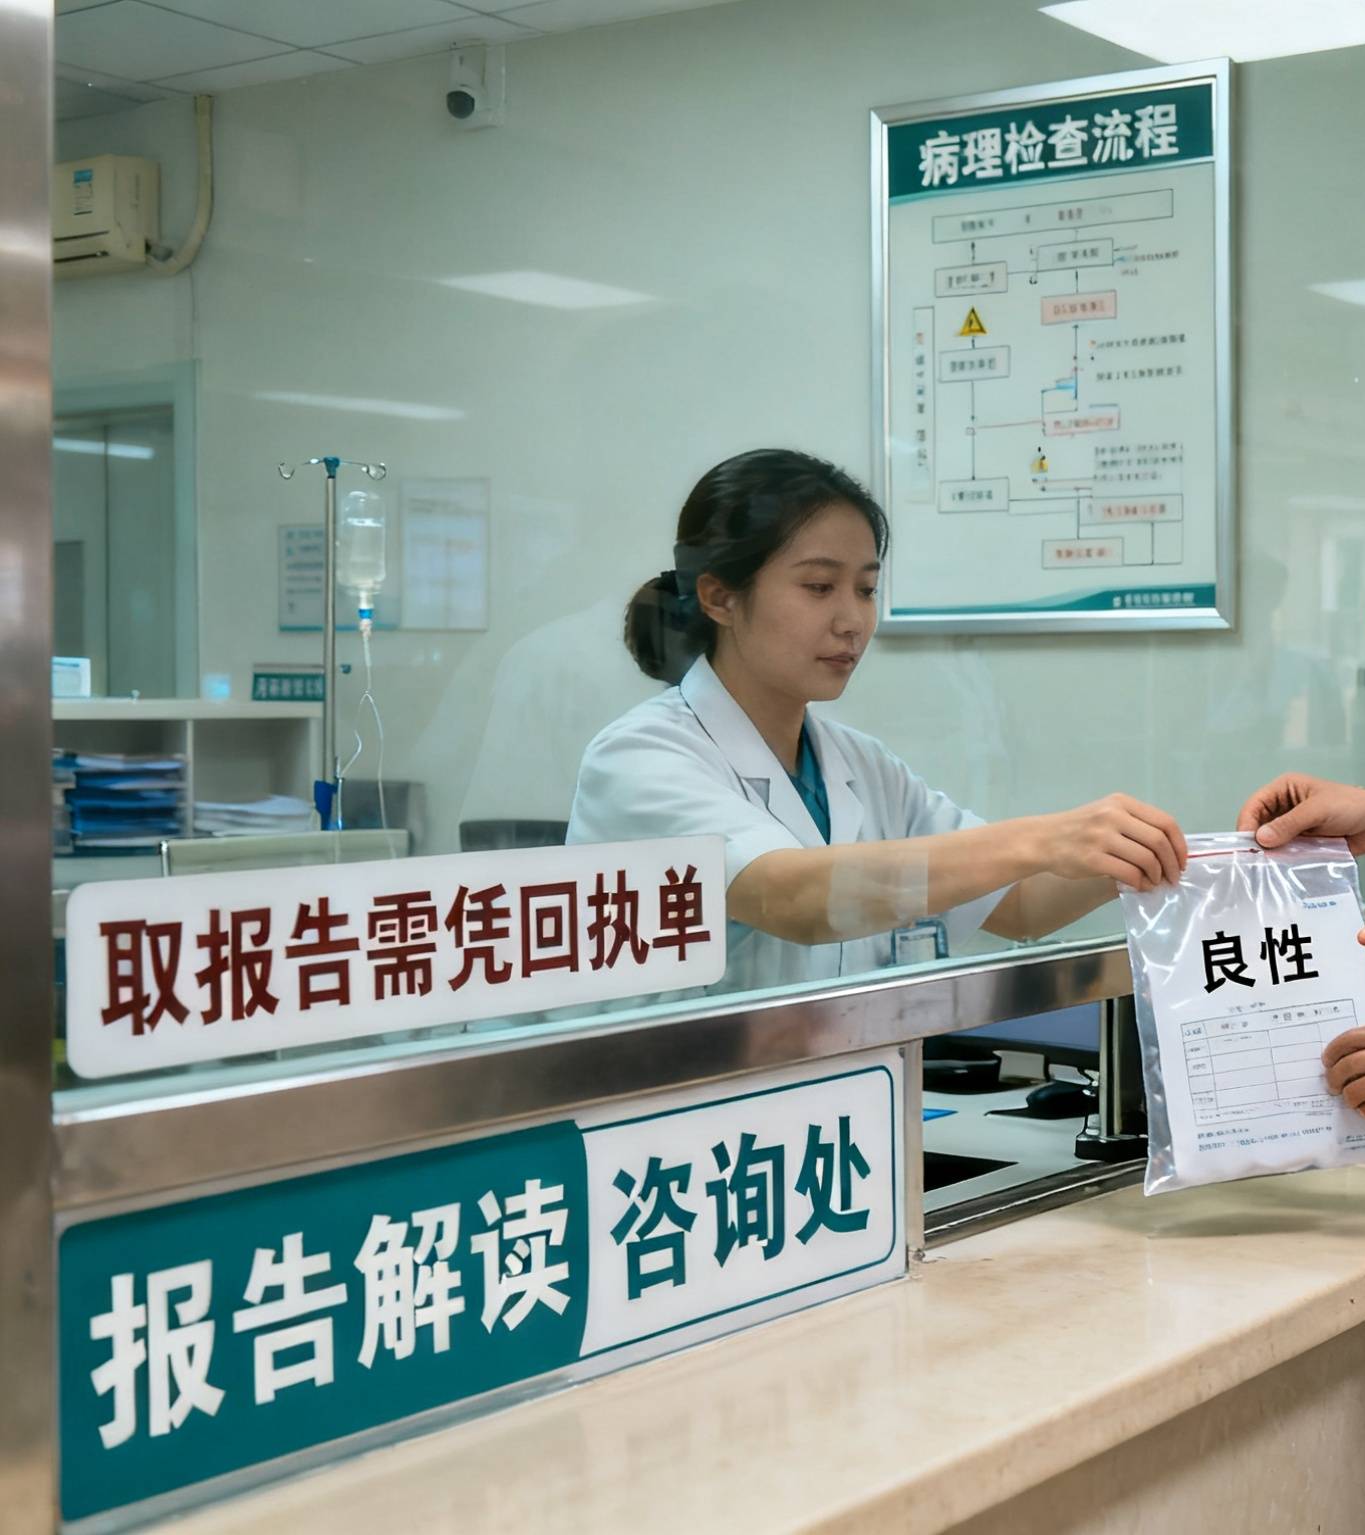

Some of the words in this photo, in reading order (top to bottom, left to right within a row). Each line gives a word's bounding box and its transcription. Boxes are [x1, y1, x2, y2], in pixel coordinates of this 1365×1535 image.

[919, 104, 1179, 187] 病理检查流程
[98, 864, 712, 1037] 取报告需凭回执单
[1202, 923, 1319, 994] 良性
[89, 1179, 572, 1450] 报告解读
[610, 1115, 871, 1301] 咨询处
